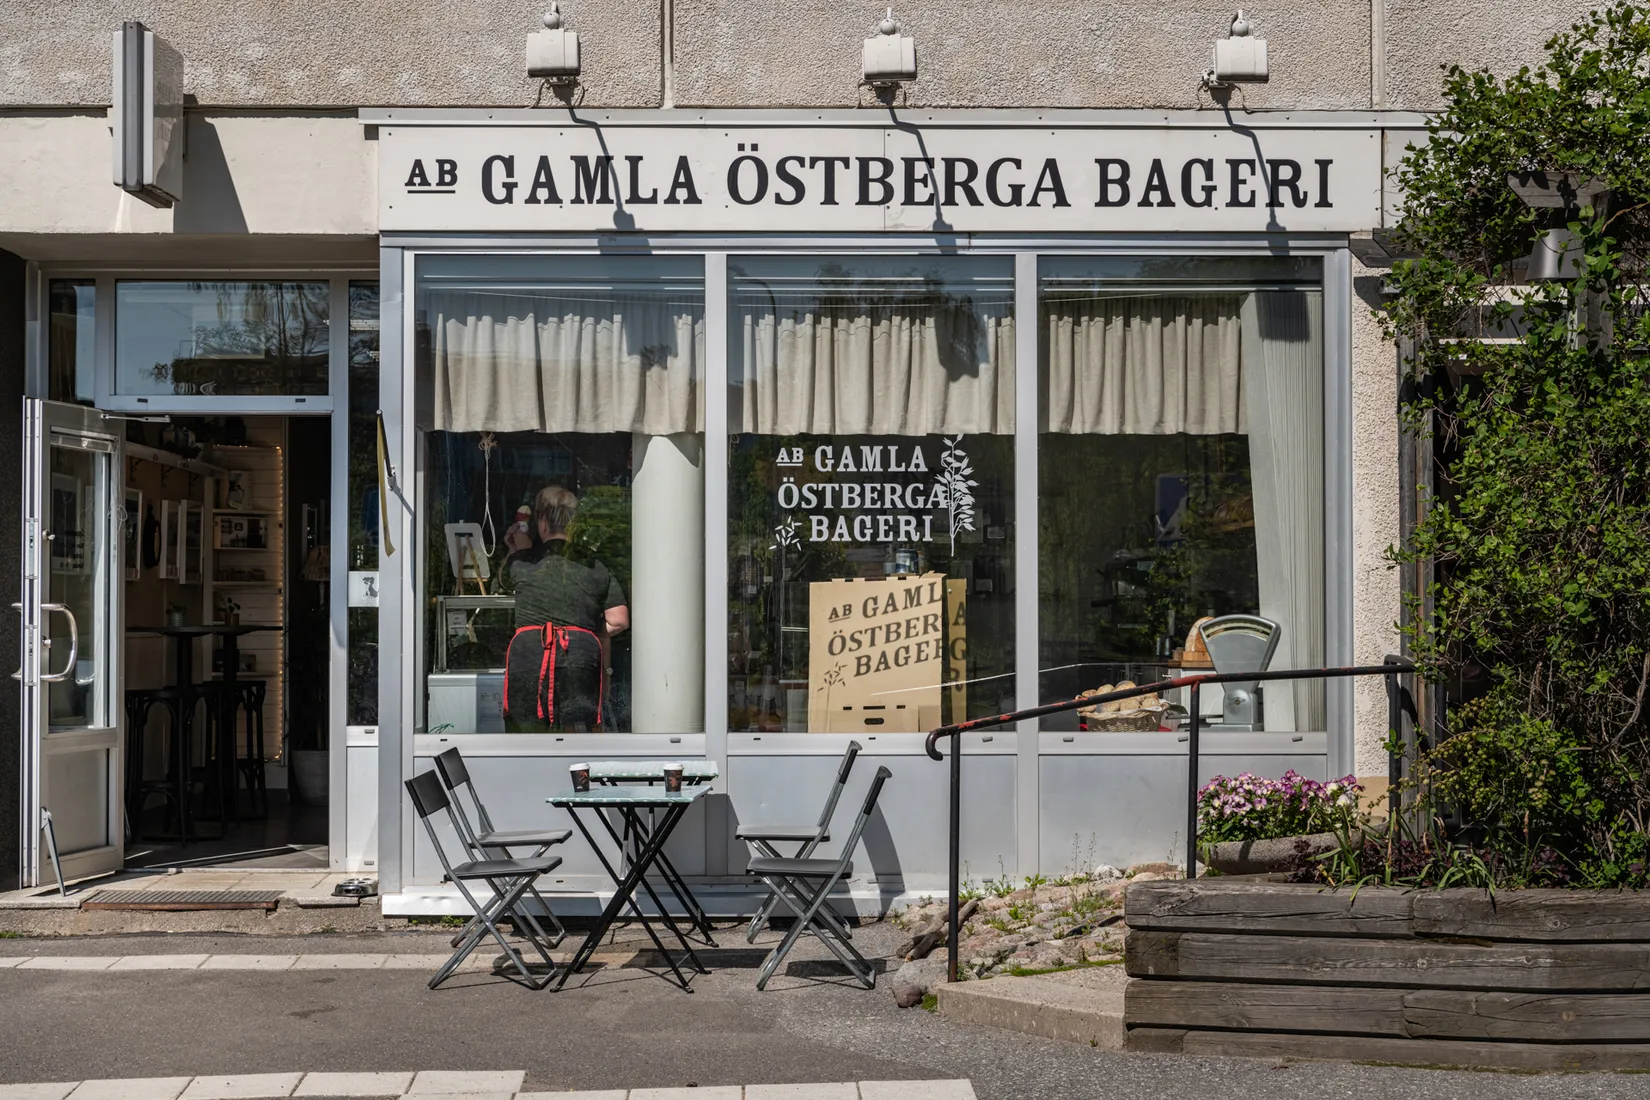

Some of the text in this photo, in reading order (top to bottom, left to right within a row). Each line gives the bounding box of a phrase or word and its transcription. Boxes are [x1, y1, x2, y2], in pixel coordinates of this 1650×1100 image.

[404, 142, 1334, 209] AB GAMLA ÖSTBERGA BAGERI
[776, 445, 929, 472] AB GAMLA
[777, 477, 950, 509] ÖSTBERGA
[809, 515, 933, 542] BAGERI
